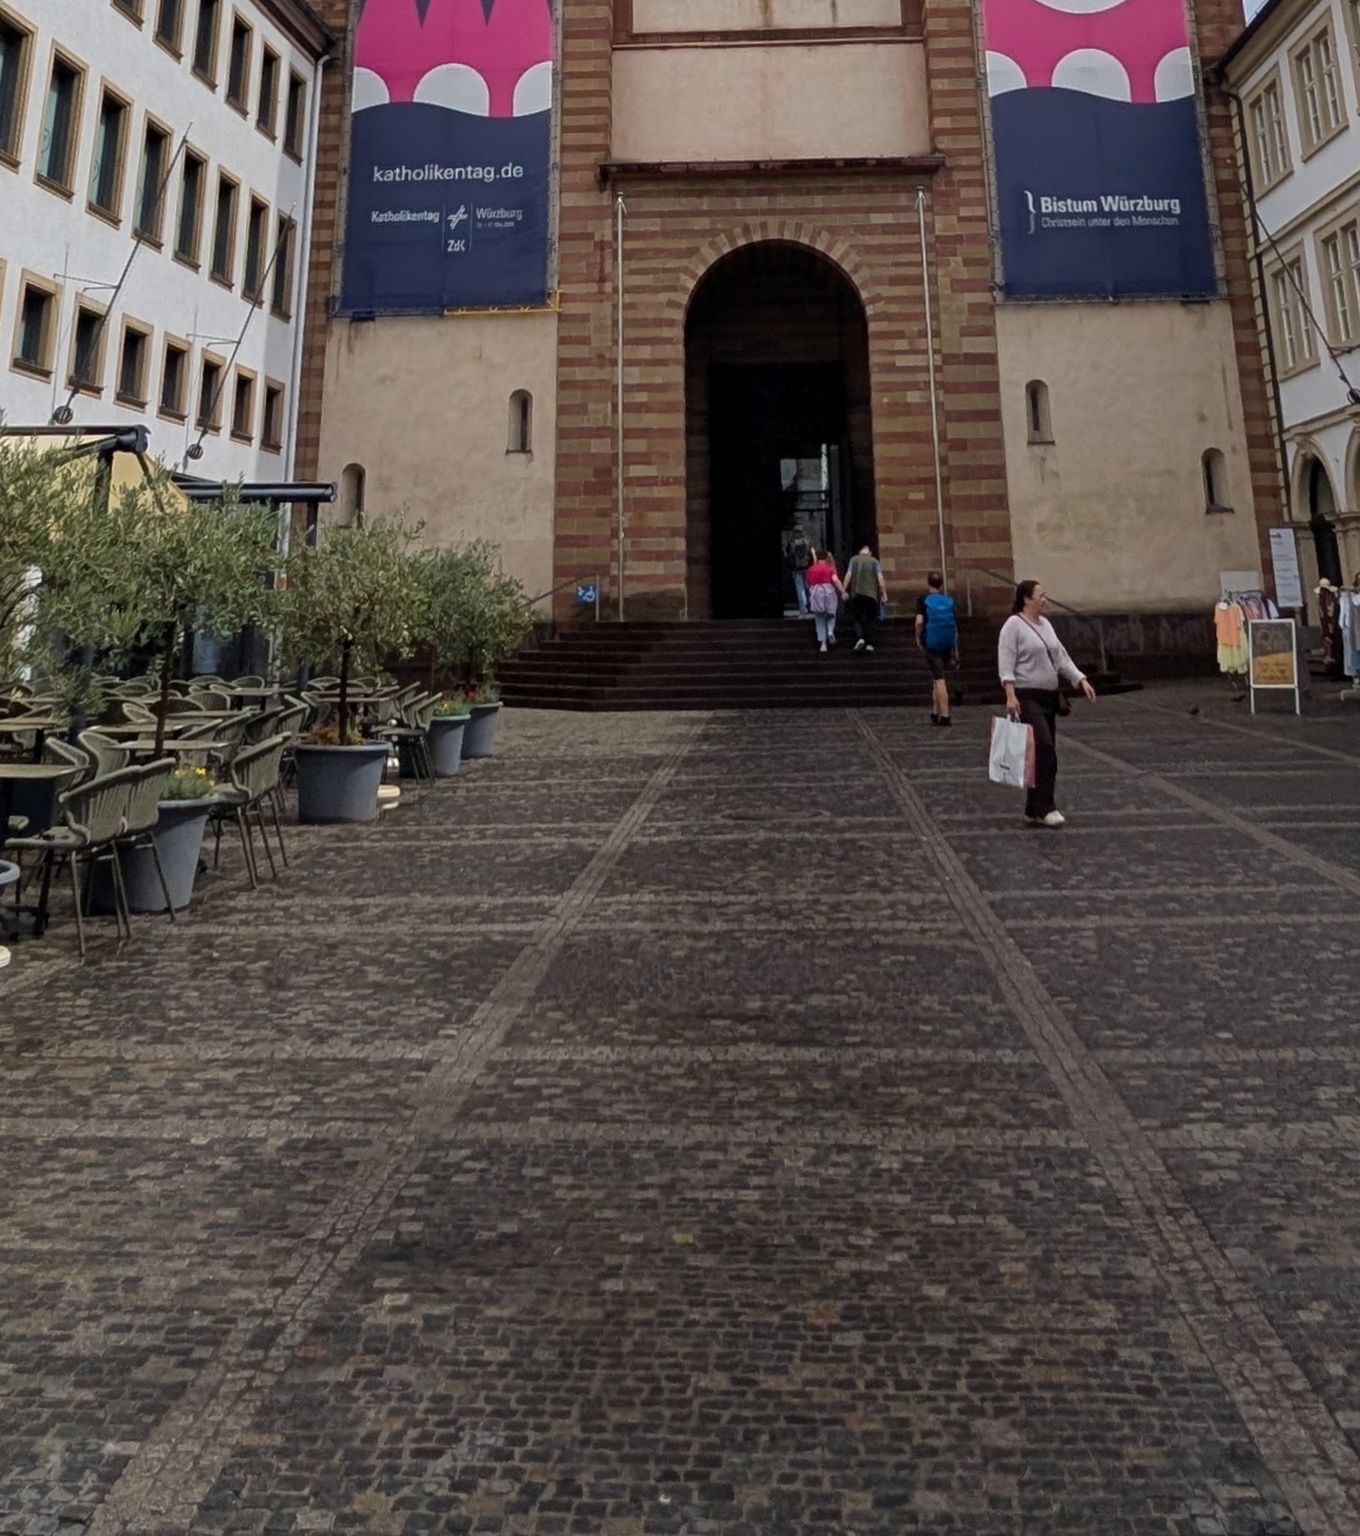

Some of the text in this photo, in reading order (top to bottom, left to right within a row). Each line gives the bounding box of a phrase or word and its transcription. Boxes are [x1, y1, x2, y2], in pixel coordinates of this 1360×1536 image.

[372, 162, 524, 183] katholikentag.de
[1040, 195, 1181, 215] Bistum Würzburg
[371, 210, 441, 223] Katholikentag
